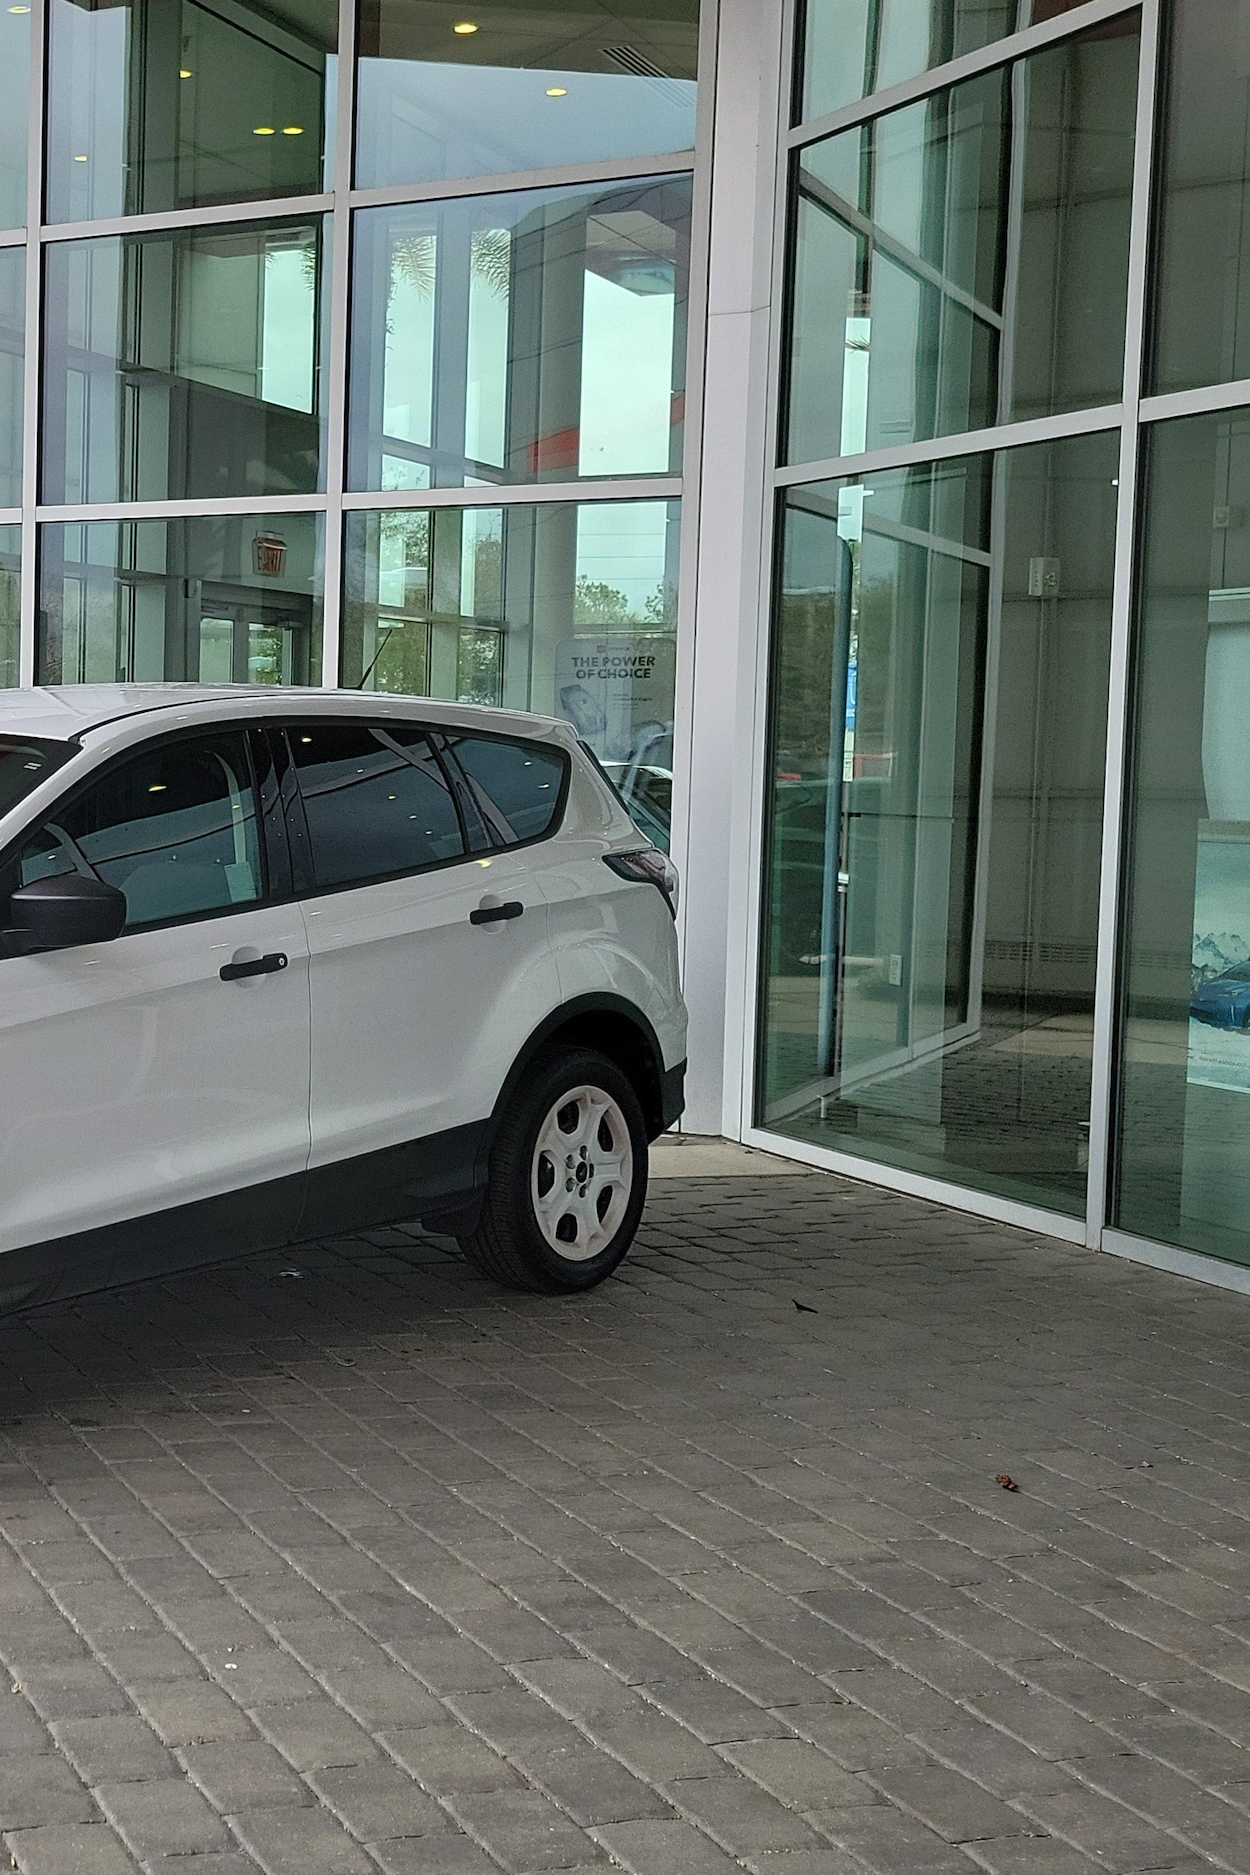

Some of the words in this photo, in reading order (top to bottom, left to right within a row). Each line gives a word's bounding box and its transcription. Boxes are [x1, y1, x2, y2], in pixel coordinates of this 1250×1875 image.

[571, 656, 599, 668] THE
[602, 655, 656, 668] POWER
[576, 669, 596, 680] OF
[597, 668, 652, 680] CHOICE
